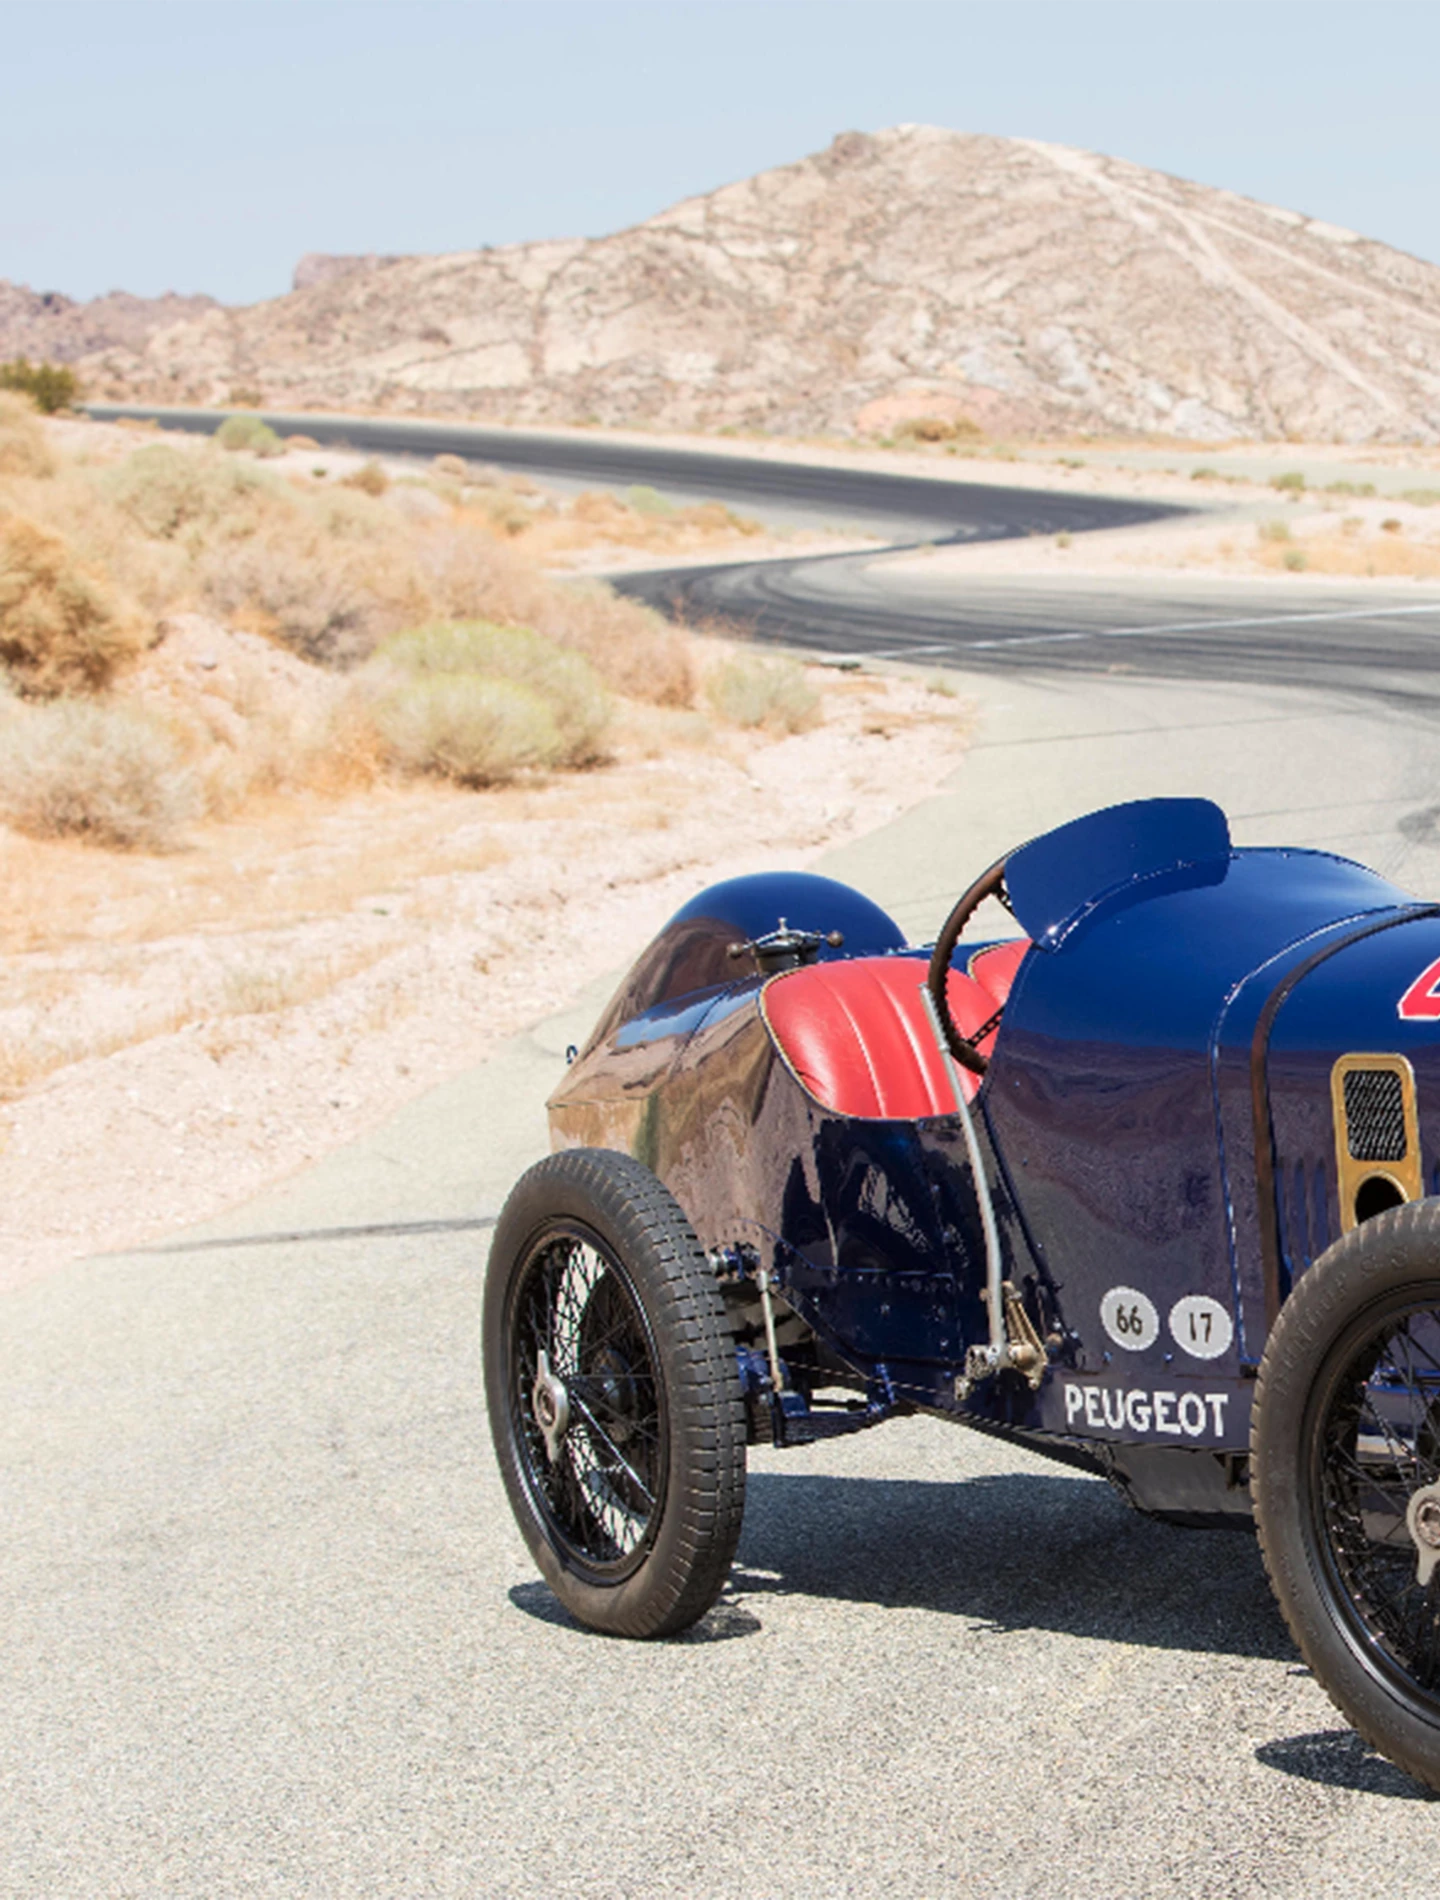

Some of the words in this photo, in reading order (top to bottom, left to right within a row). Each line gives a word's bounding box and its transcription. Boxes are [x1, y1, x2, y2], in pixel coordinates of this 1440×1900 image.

[1116, 1304, 1142, 1336] 66
[1189, 1312, 1212, 1343] 17
[1064, 1384, 1229, 1437] PEUGEOT
